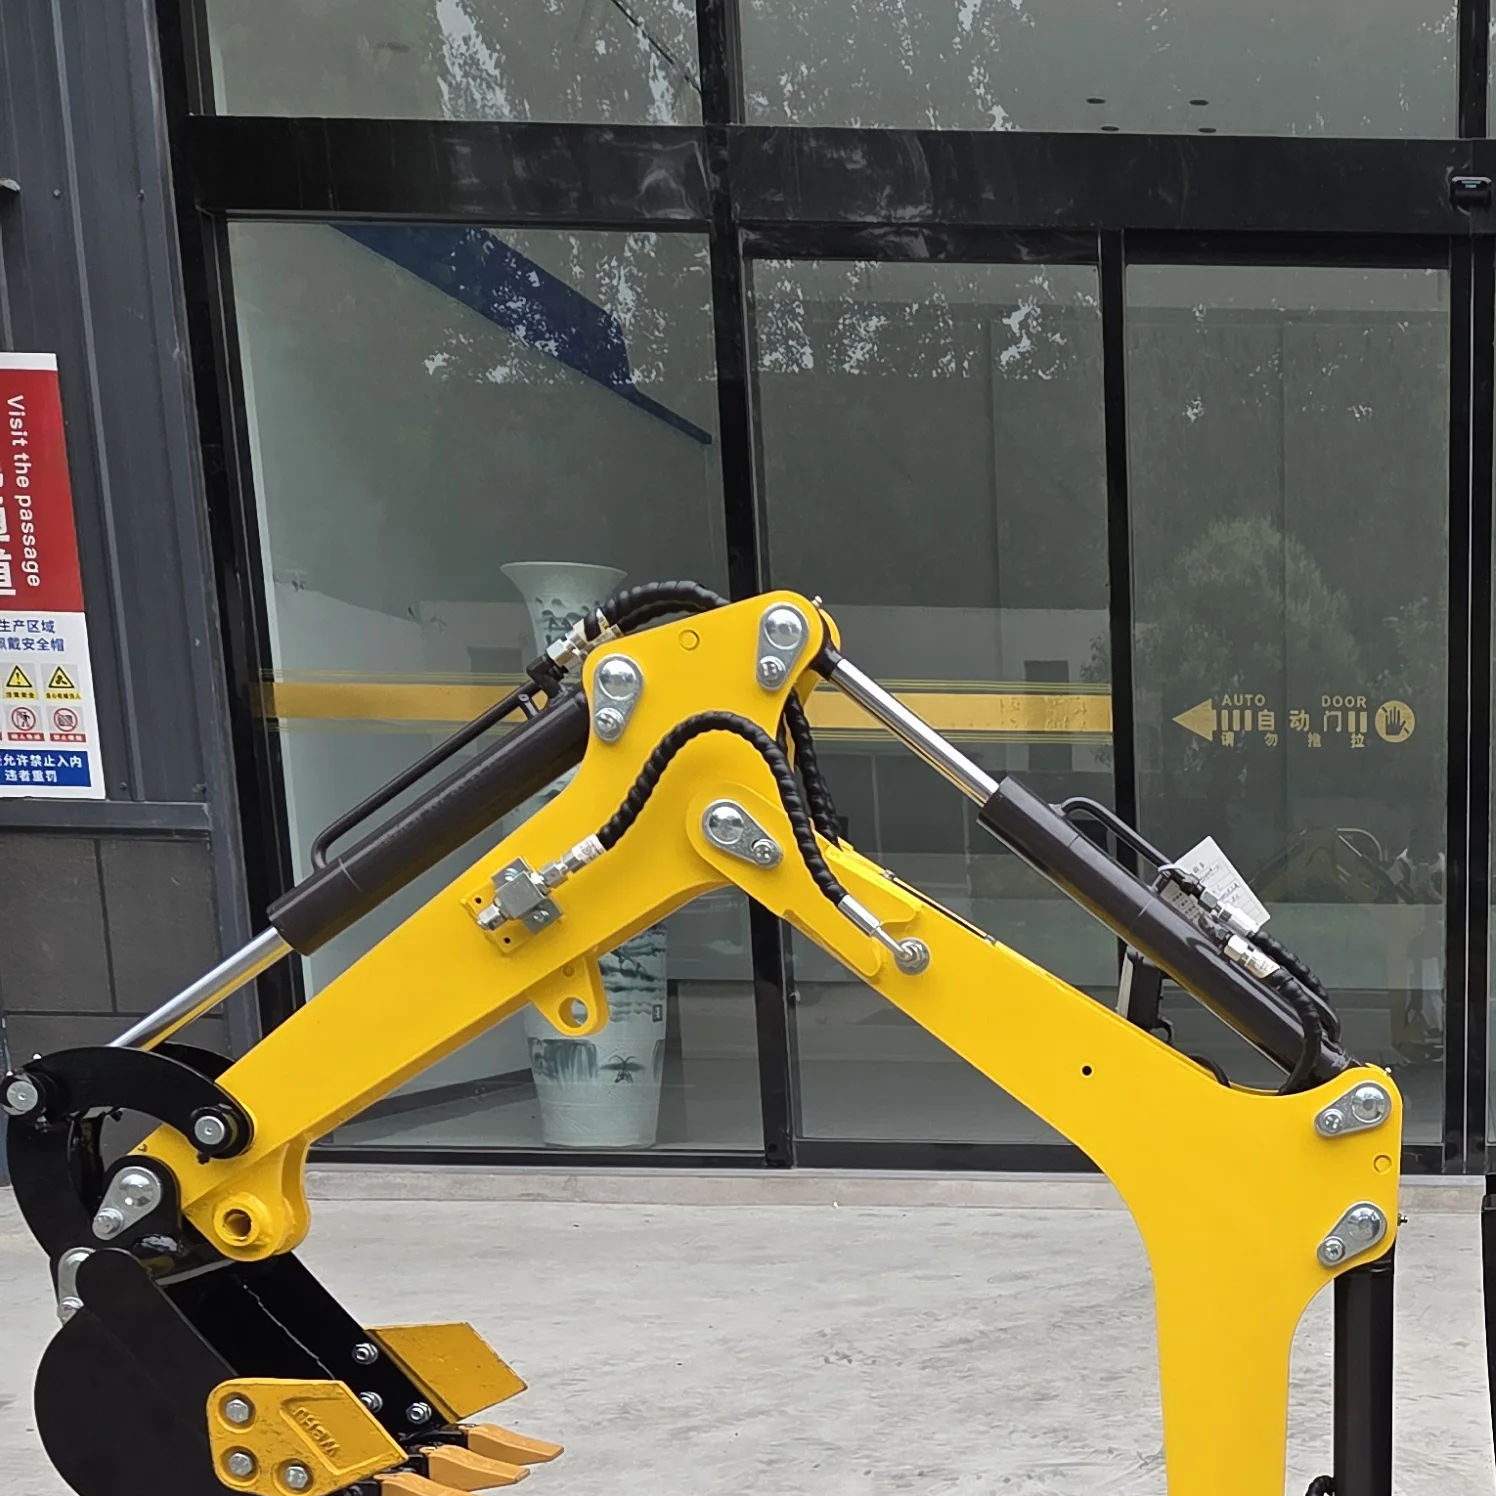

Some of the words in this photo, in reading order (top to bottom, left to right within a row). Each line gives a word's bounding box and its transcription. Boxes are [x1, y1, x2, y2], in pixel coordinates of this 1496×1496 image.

[7, 395, 28, 446] Visit
[13, 452, 31, 488] the
[14, 494, 41, 587] passage
[0, 618, 56, 634] 生产区域
[1221, 693, 1266, 707] AUTO
[1321, 694, 1367, 708] DOOR
[1258, 709, 1342, 732] 自动门
[1221, 732, 1366, 748] 请勿推拉
